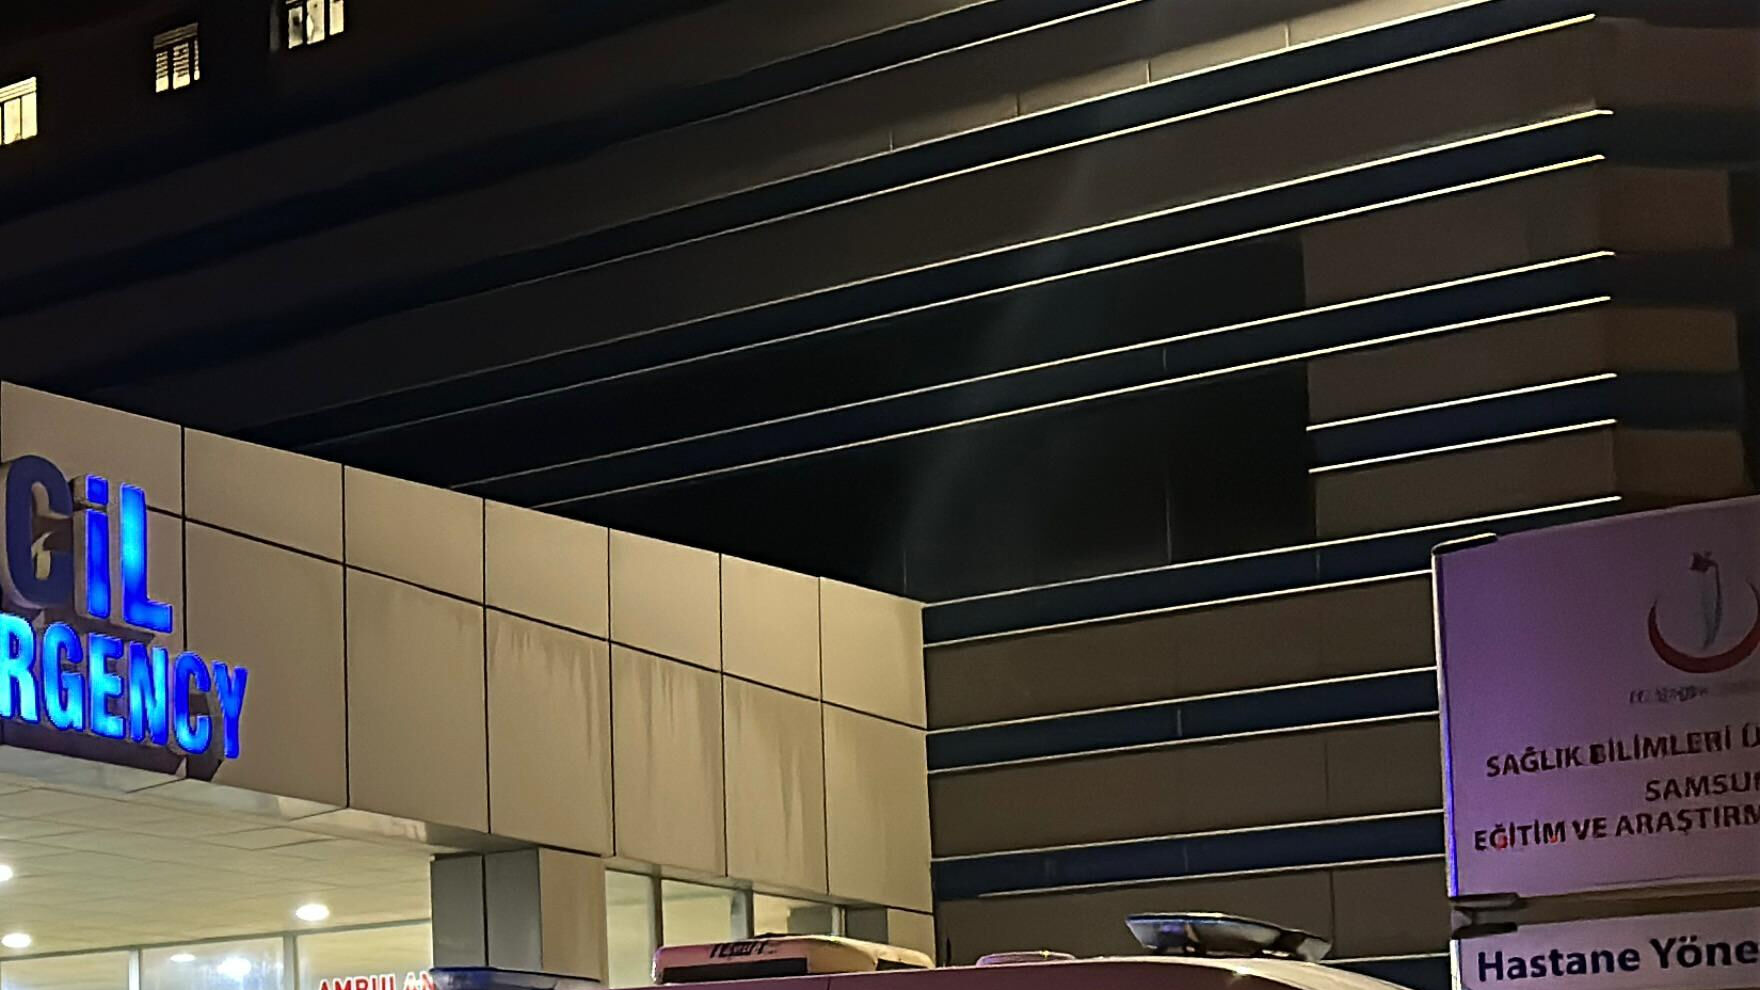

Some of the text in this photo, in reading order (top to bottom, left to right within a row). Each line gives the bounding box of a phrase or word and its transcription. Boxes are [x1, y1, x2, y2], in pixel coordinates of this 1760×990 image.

[1486, 745, 1583, 778] SAĞLIK
[1473, 819, 1567, 851] EĞİTİM
[1572, 817, 1607, 841] VE
[1477, 935, 1760, 982] Hastane Yöne
